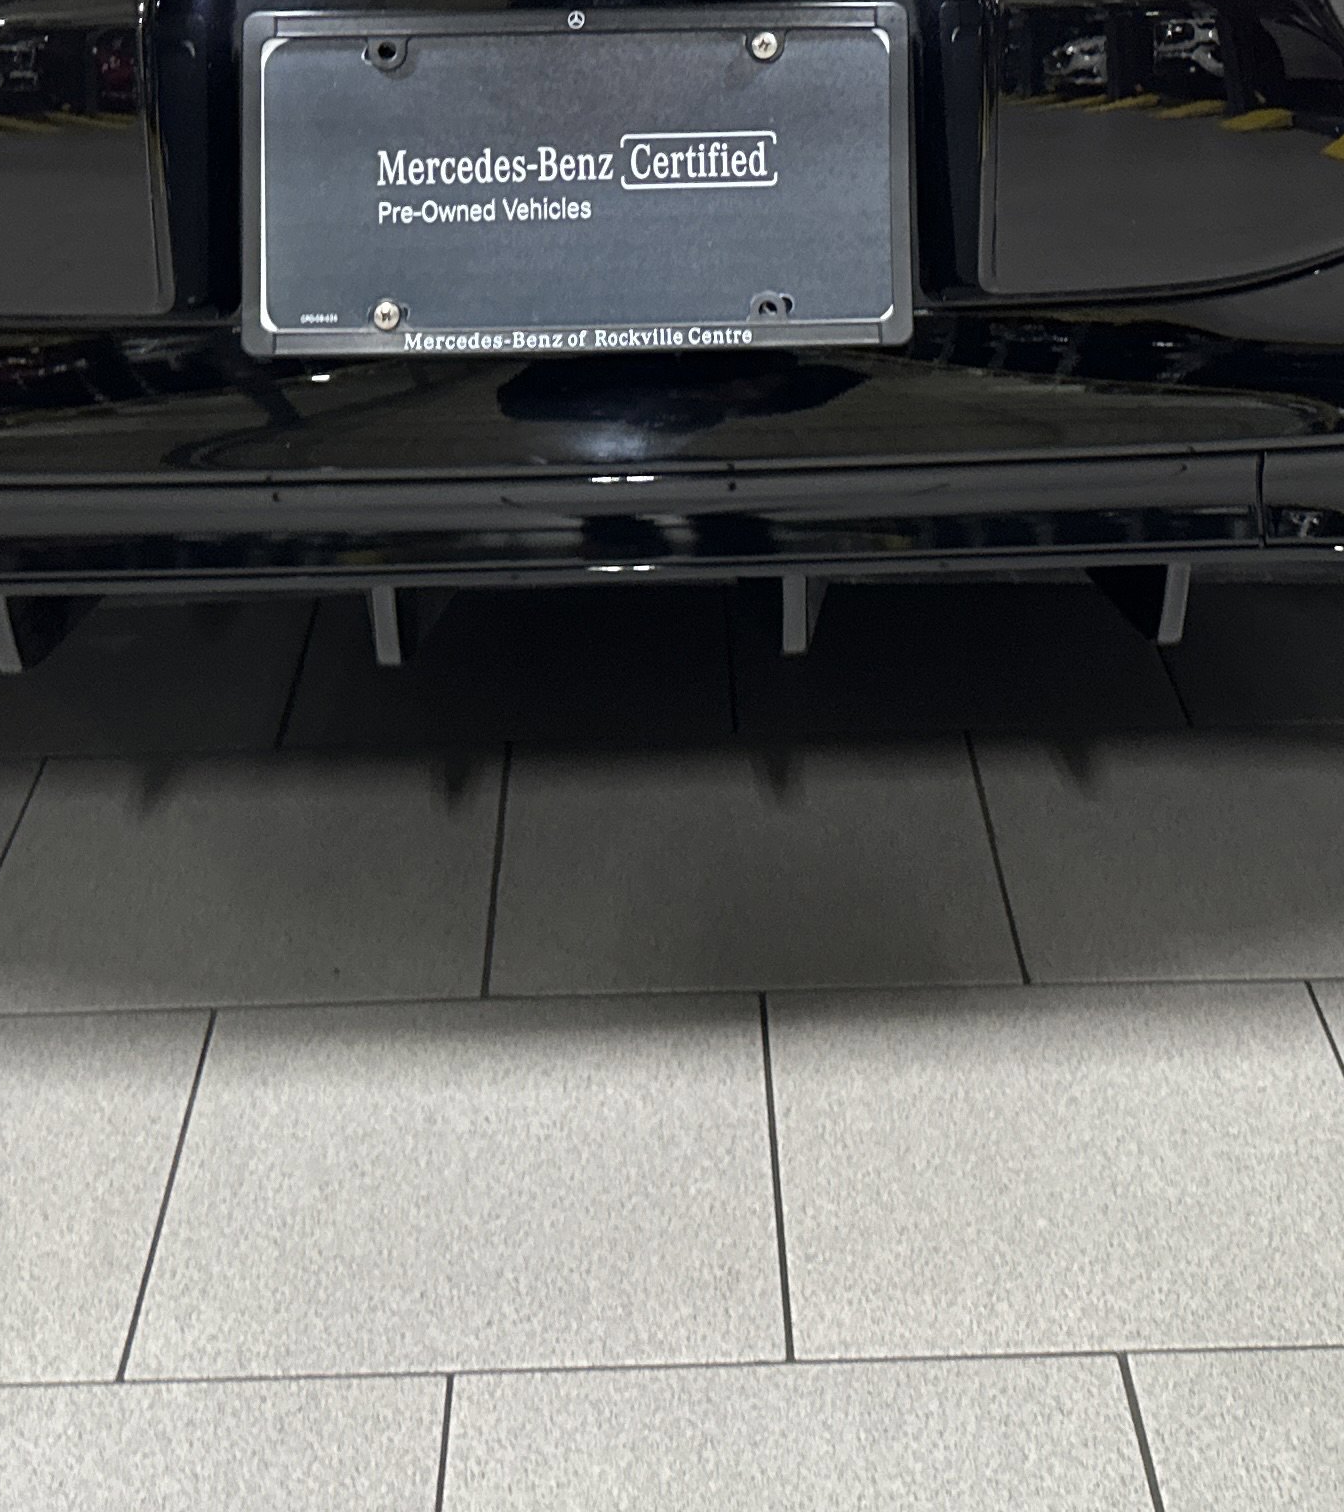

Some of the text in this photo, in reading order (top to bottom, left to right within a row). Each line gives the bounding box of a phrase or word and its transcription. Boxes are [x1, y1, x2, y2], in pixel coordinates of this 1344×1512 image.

[377, 141, 768, 186] Mercedes-Benz Certified
[377, 196, 592, 225] Pre-Owned Vehicles
[404, 326, 753, 351] Mercedes-Benz of Rockville Centre
